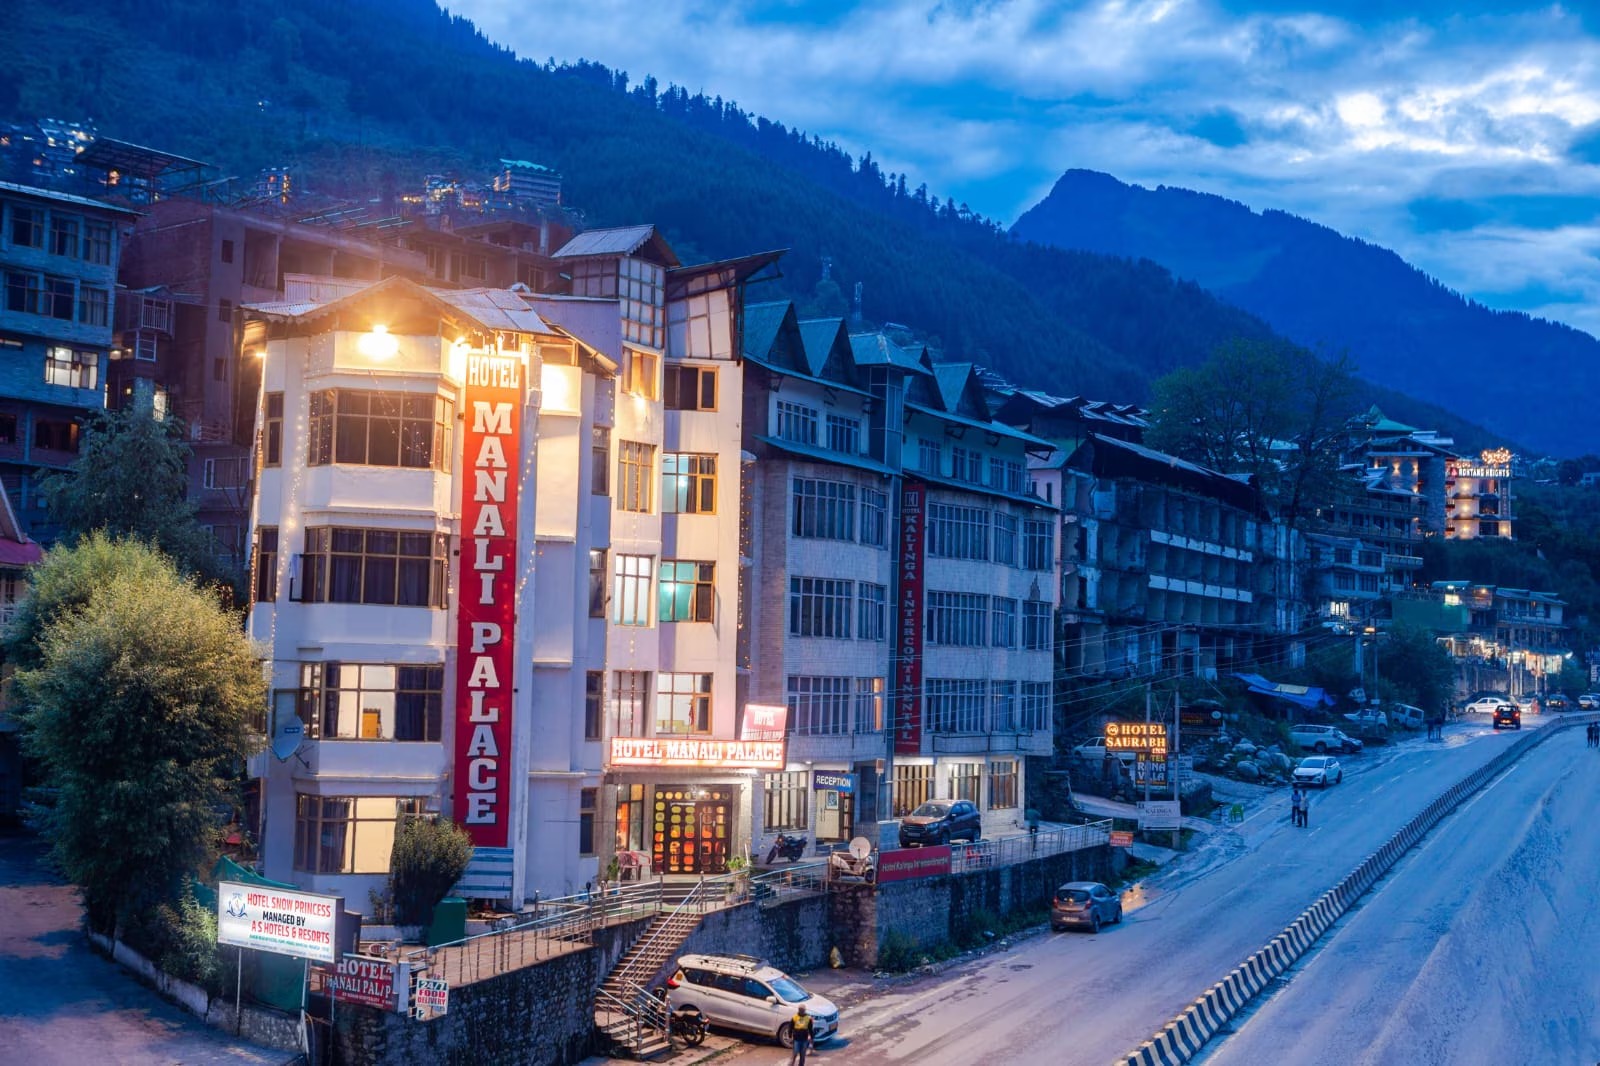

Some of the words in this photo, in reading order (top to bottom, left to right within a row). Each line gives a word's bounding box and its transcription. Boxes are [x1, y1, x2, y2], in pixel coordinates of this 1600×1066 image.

[468, 356, 519, 389] HOTEL
[472, 401, 513, 604] MANALI
[904, 515, 917, 580] KALINGA
[465, 621, 501, 824] PALACE
[1121, 724, 1166, 735] HOTEL
[1106, 737, 1166, 748] SAURABH
[612, 739, 663, 758] HOTEL
[666, 740, 723, 760] MANALI
[725, 742, 783, 761] PALACE
[1139, 754, 1165, 762] HTEL
[1137, 762, 1166, 771] RNA
[815, 775, 851, 788] RECEPTION
[247, 893, 269, 908] HOTEL
[271, 896, 292, 911] SNOW
[295, 900, 331, 917] PRINCESS
[262, 910, 295, 925] MANAGED
[296, 916, 306, 926] BY
[251, 920, 256, 932] A
[258, 921, 263, 933] S
[264, 922, 289, 938] HOTELS
[291, 928, 297, 938] &
[298, 929, 330, 944] RESORTS
[420, 981, 446, 991] 24/7
[417, 996, 446, 1006] DELIVERY
[418, 989, 446, 999] FOOD
